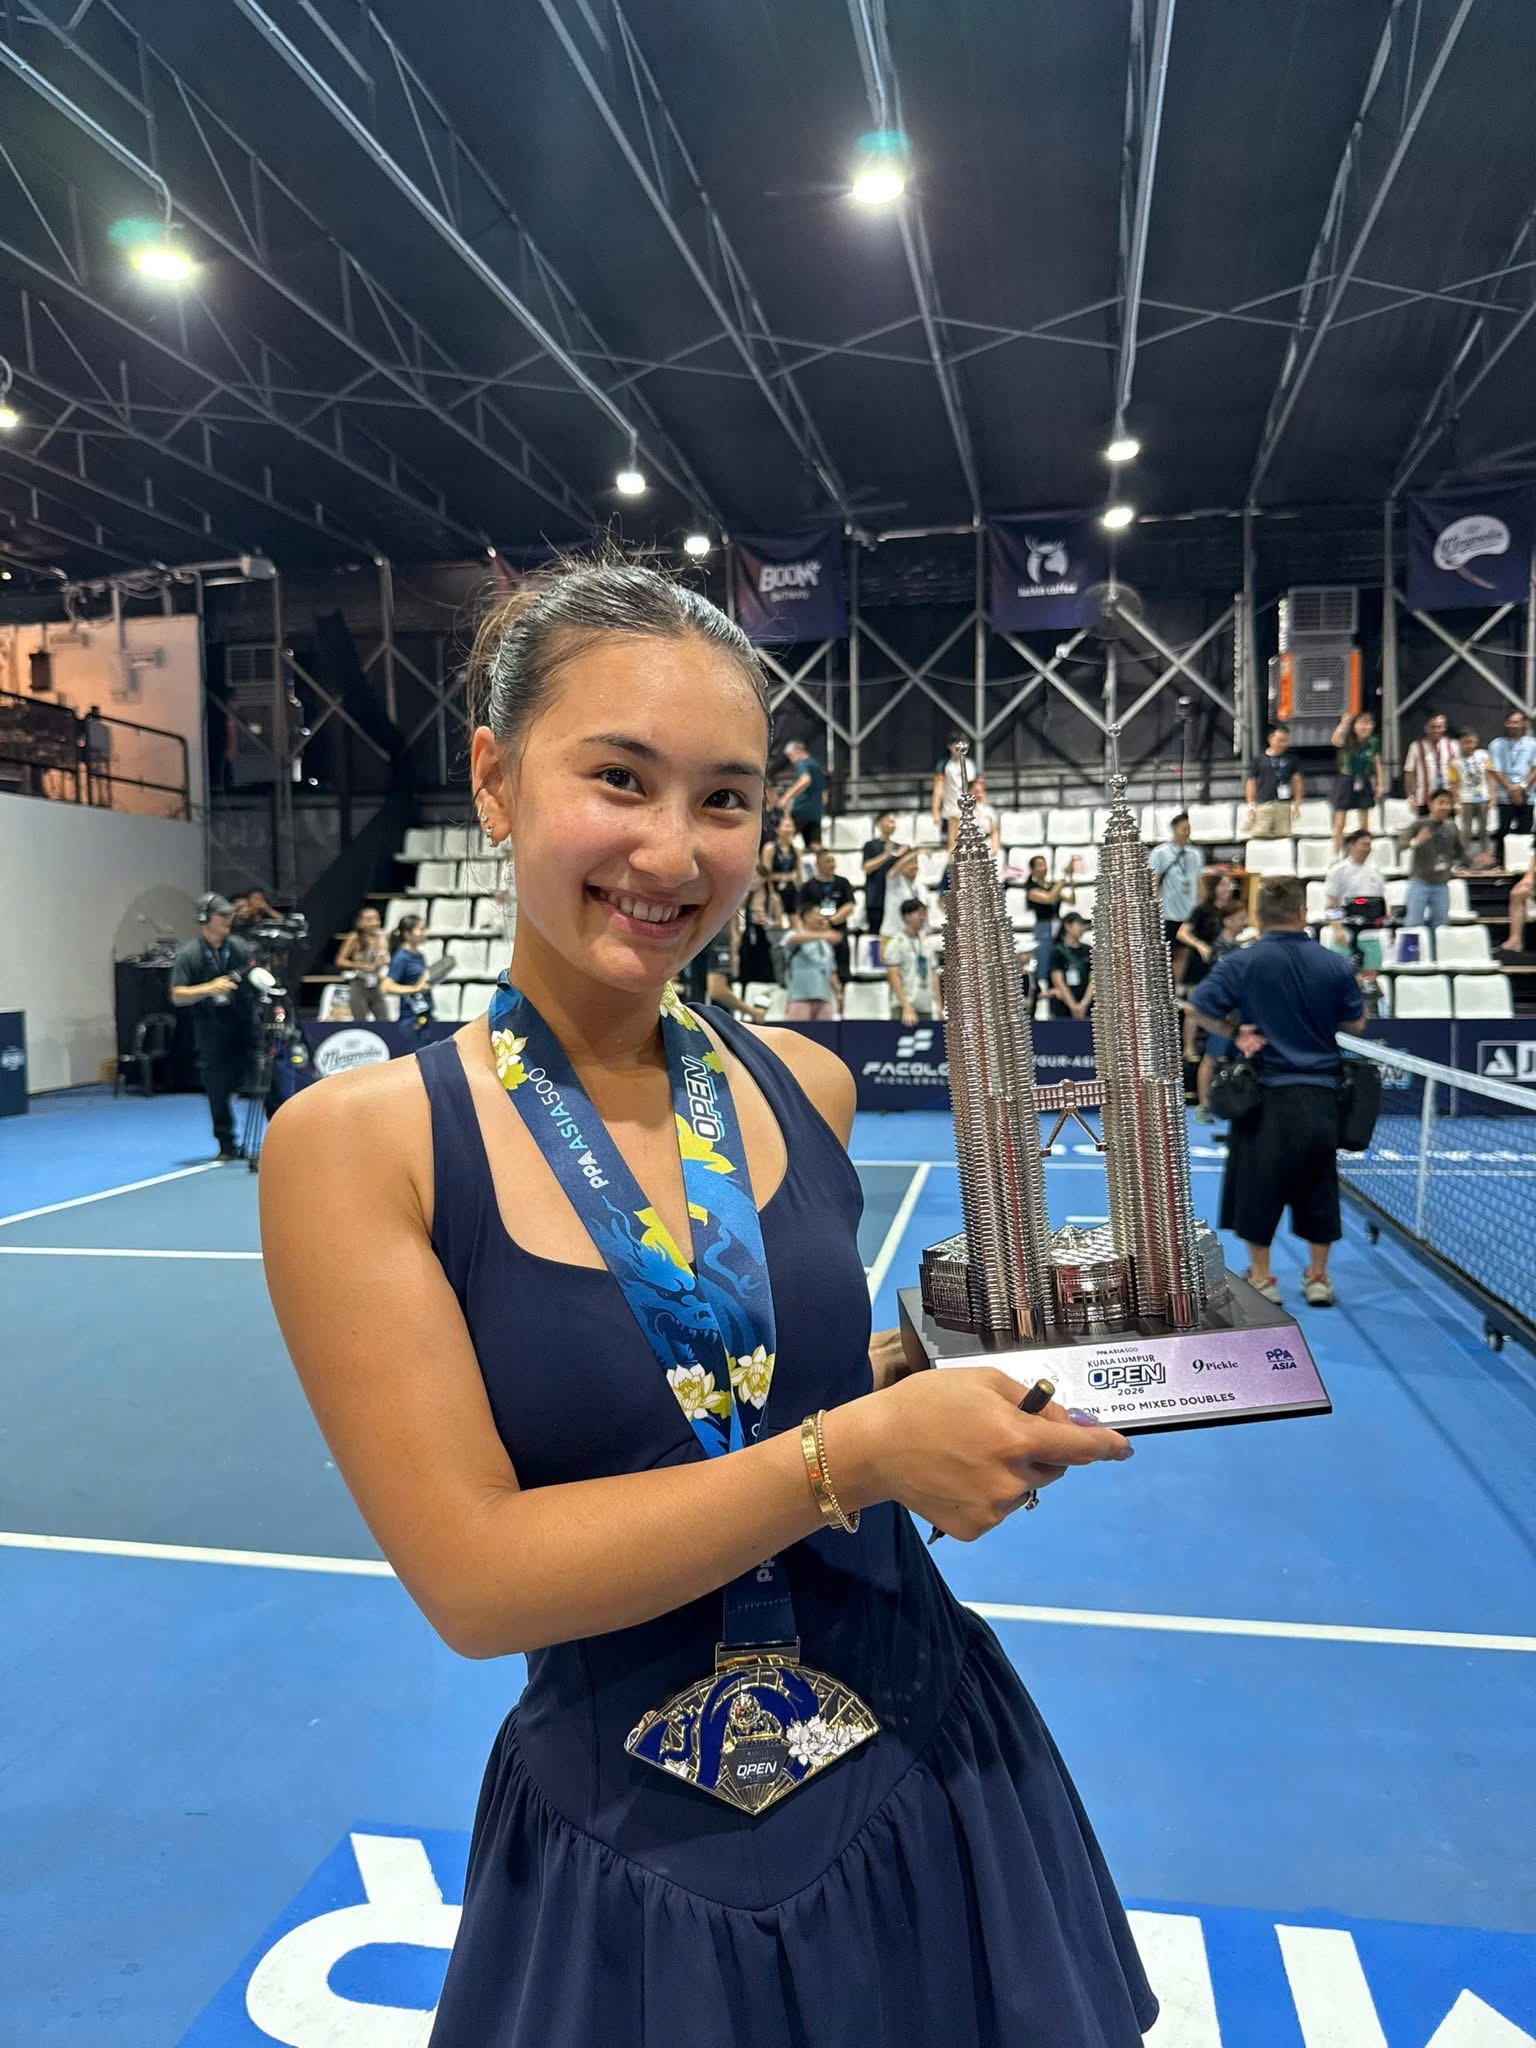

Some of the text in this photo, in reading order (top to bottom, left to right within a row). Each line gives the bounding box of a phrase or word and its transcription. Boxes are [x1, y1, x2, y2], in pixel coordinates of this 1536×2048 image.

[862, 1062, 950, 1076] FACOLO
[681, 1055, 725, 1142] OPEN
[577, 1150, 610, 1189] PPA
[1087, 1354, 1156, 1368] KUALA LUMPUR
[1265, 1348, 1294, 1361] PPA
[1272, 1362, 1297, 1371] ASIA
[1088, 1362, 1166, 1389] OPEN
[1117, 1387, 1145, 1396] 2026
[1111, 1403, 1136, 1413] PRO
[1140, 1398, 1177, 1410] MIXED
[1180, 1393, 1236, 1406] DOUBLES
[736, 1761, 777, 1777] OPEN
